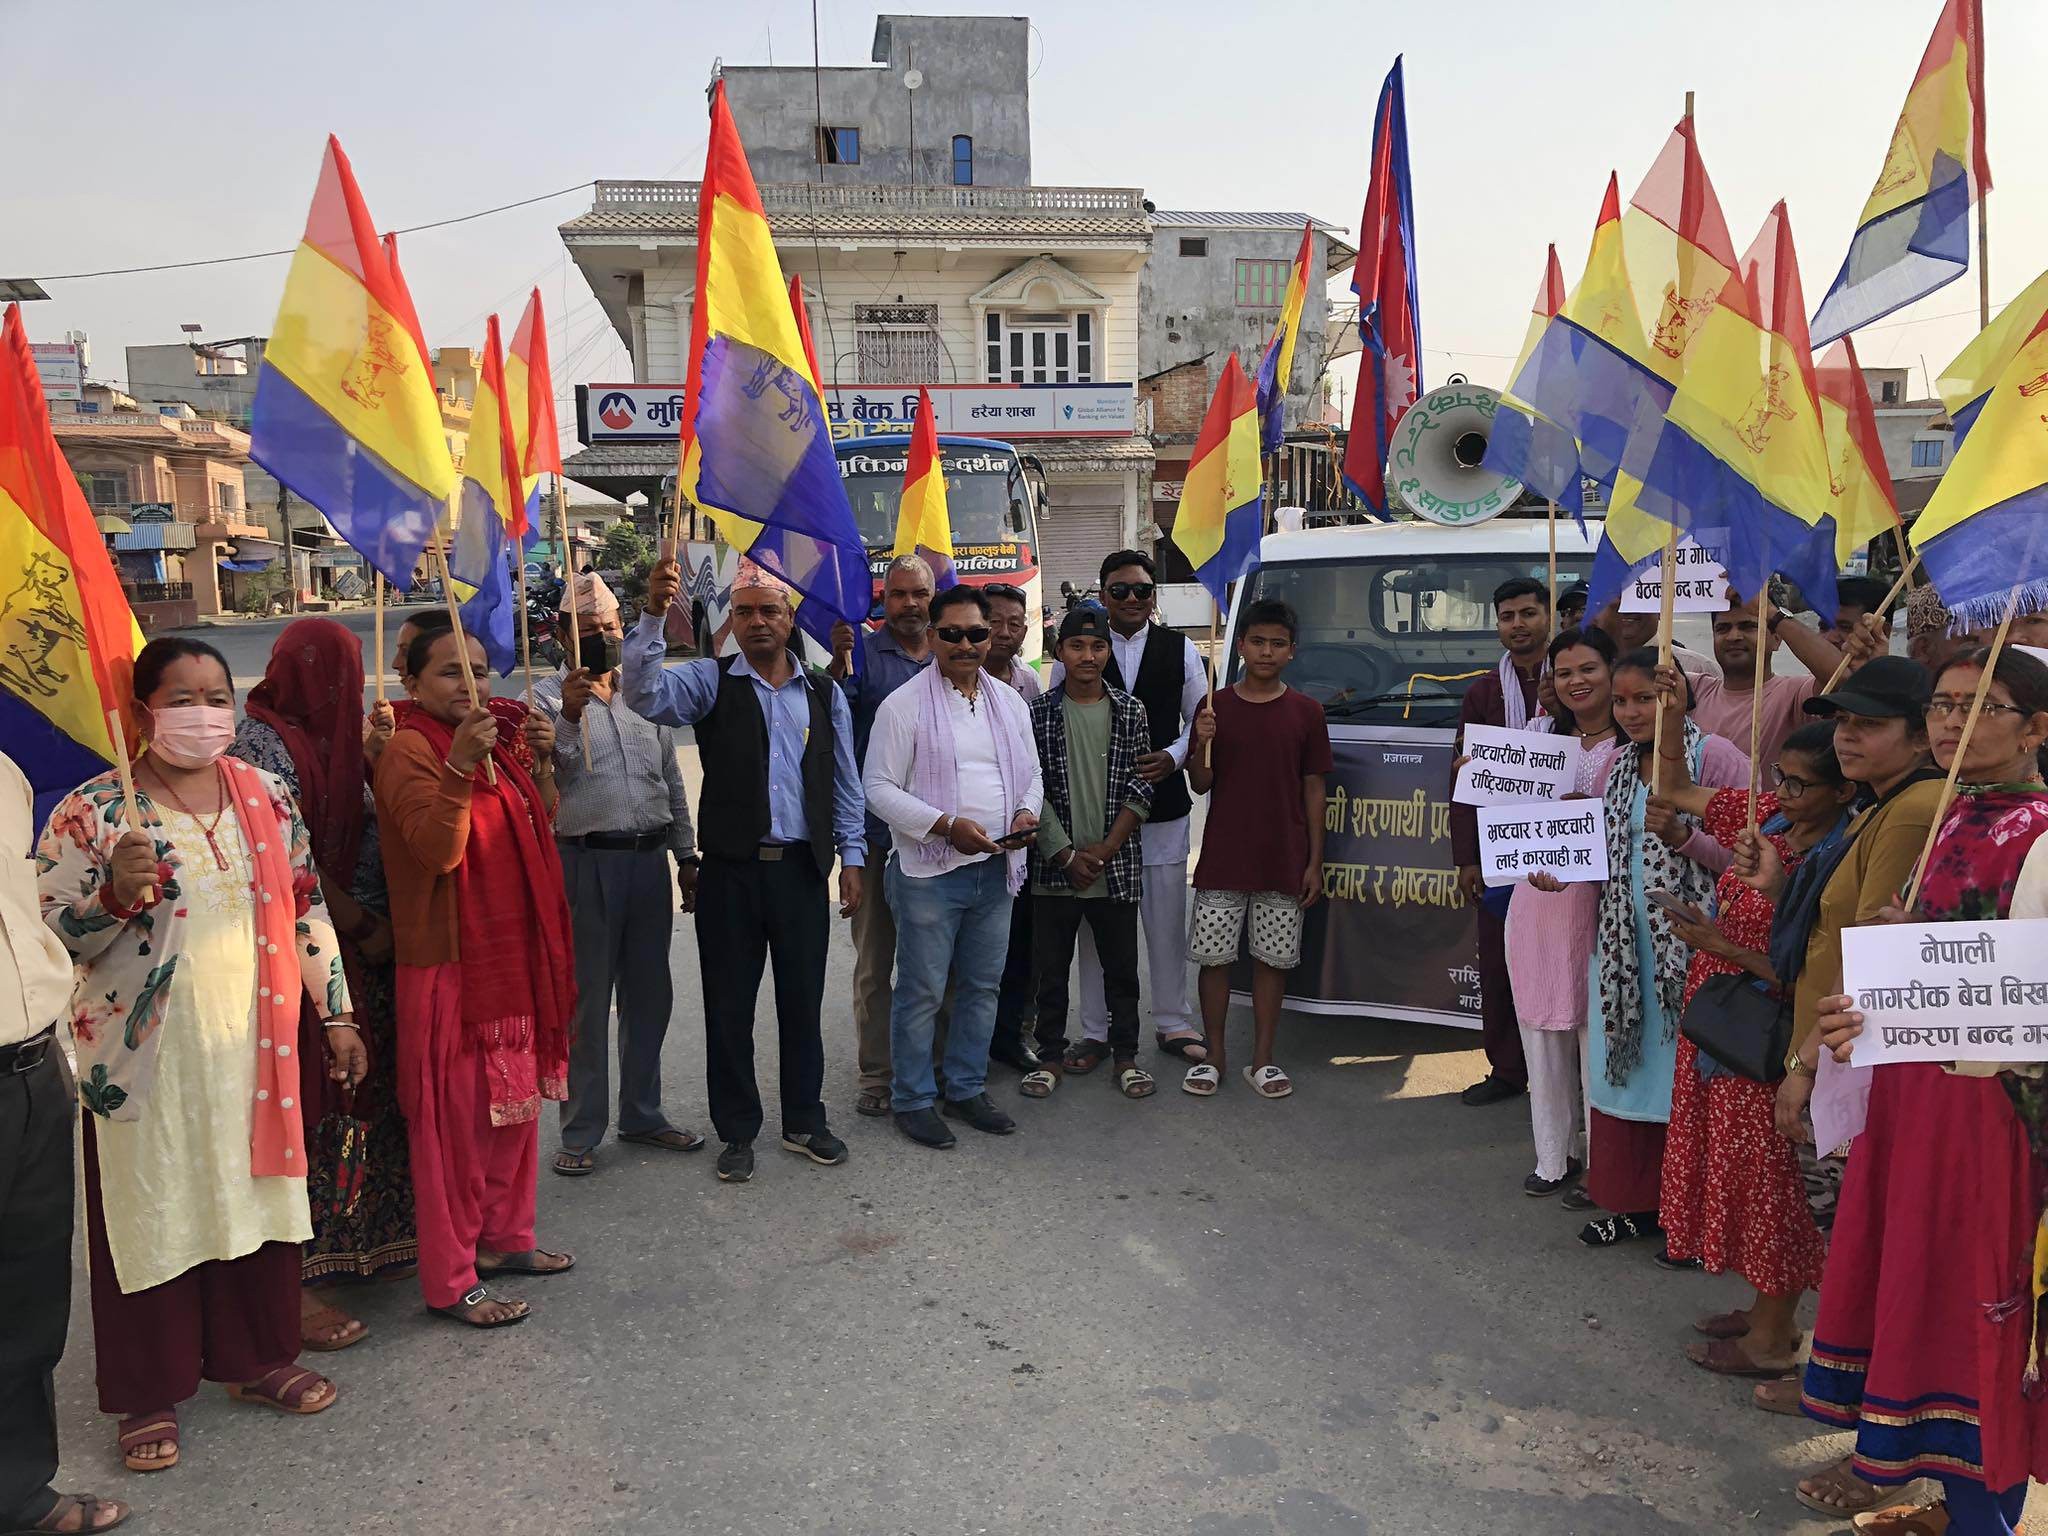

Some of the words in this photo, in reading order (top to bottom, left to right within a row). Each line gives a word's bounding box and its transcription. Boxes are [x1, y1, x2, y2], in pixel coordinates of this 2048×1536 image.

[971, 403, 1002, 419] हरैया
[1005, 406, 1036, 418] शाखा
[954, 453, 1010, 474] दर्शन
[1694, 580, 1714, 598] गर
[1382, 752, 1424, 765] प्रजातन्त्र
[1470, 743, 1527, 767] भ्रष्टचारीको
[1537, 781, 1556, 799] गर
[1351, 788, 1428, 839] शरणार्थी
[1487, 821, 1532, 843] भ्रष्टचार
[1534, 820, 1544, 838] र
[1546, 811, 1595, 839] भ्रष्टचारी
[1495, 849, 1519, 870] लाई
[1522, 844, 1570, 867] कारवाही
[1573, 848, 1592, 866] गर
[1372, 865, 1388, 905] र
[1919, 931, 1996, 965] नेपाली
[1857, 979, 1951, 1011] नागरीक
[1957, 977, 1993, 1007] बेच
[1881, 1026, 1960, 1049] प्रकरण
[1967, 1025, 2015, 1046] बन्द
